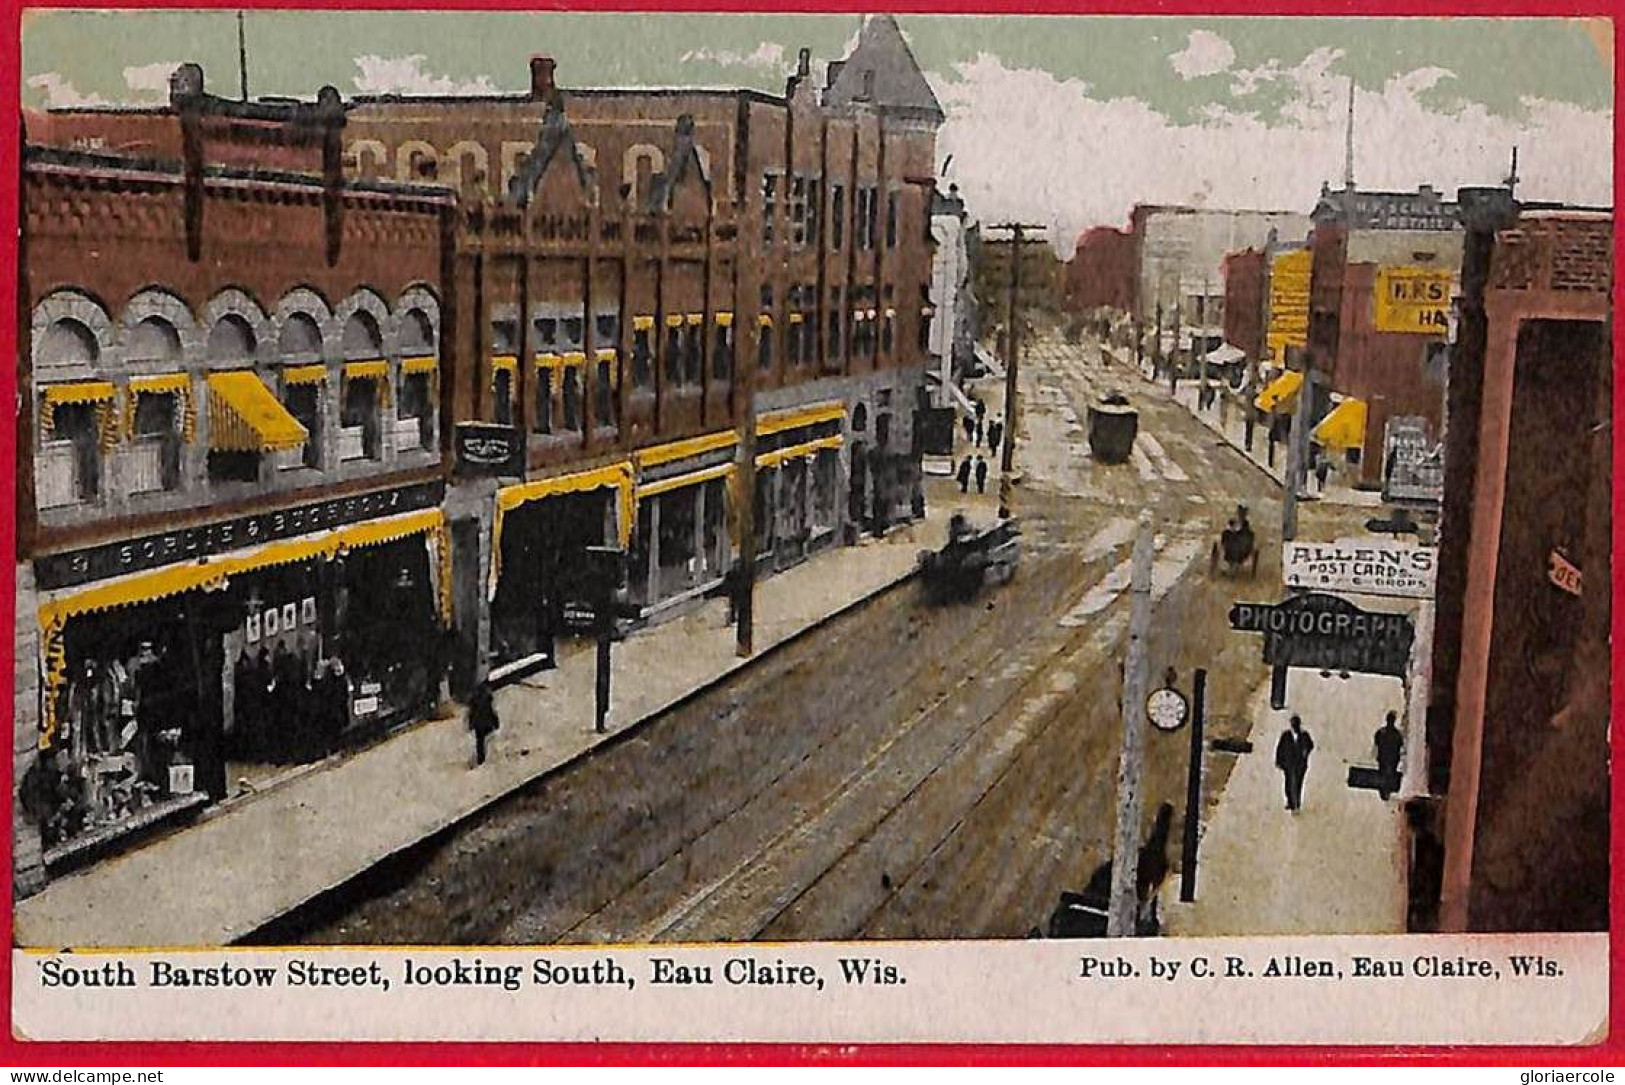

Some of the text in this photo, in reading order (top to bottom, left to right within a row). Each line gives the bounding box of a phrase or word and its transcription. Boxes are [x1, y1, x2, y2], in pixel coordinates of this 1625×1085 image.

[1291, 547, 1431, 571] ALLEN'S
[1309, 563, 1346, 574] POST
[42, 957, 907, 991] South Barstow Street, looking South, Eau Claire, Wis.
[1080, 955, 1564, 981] Pub. by C. R. Allen, Eau Claire, Wis.
